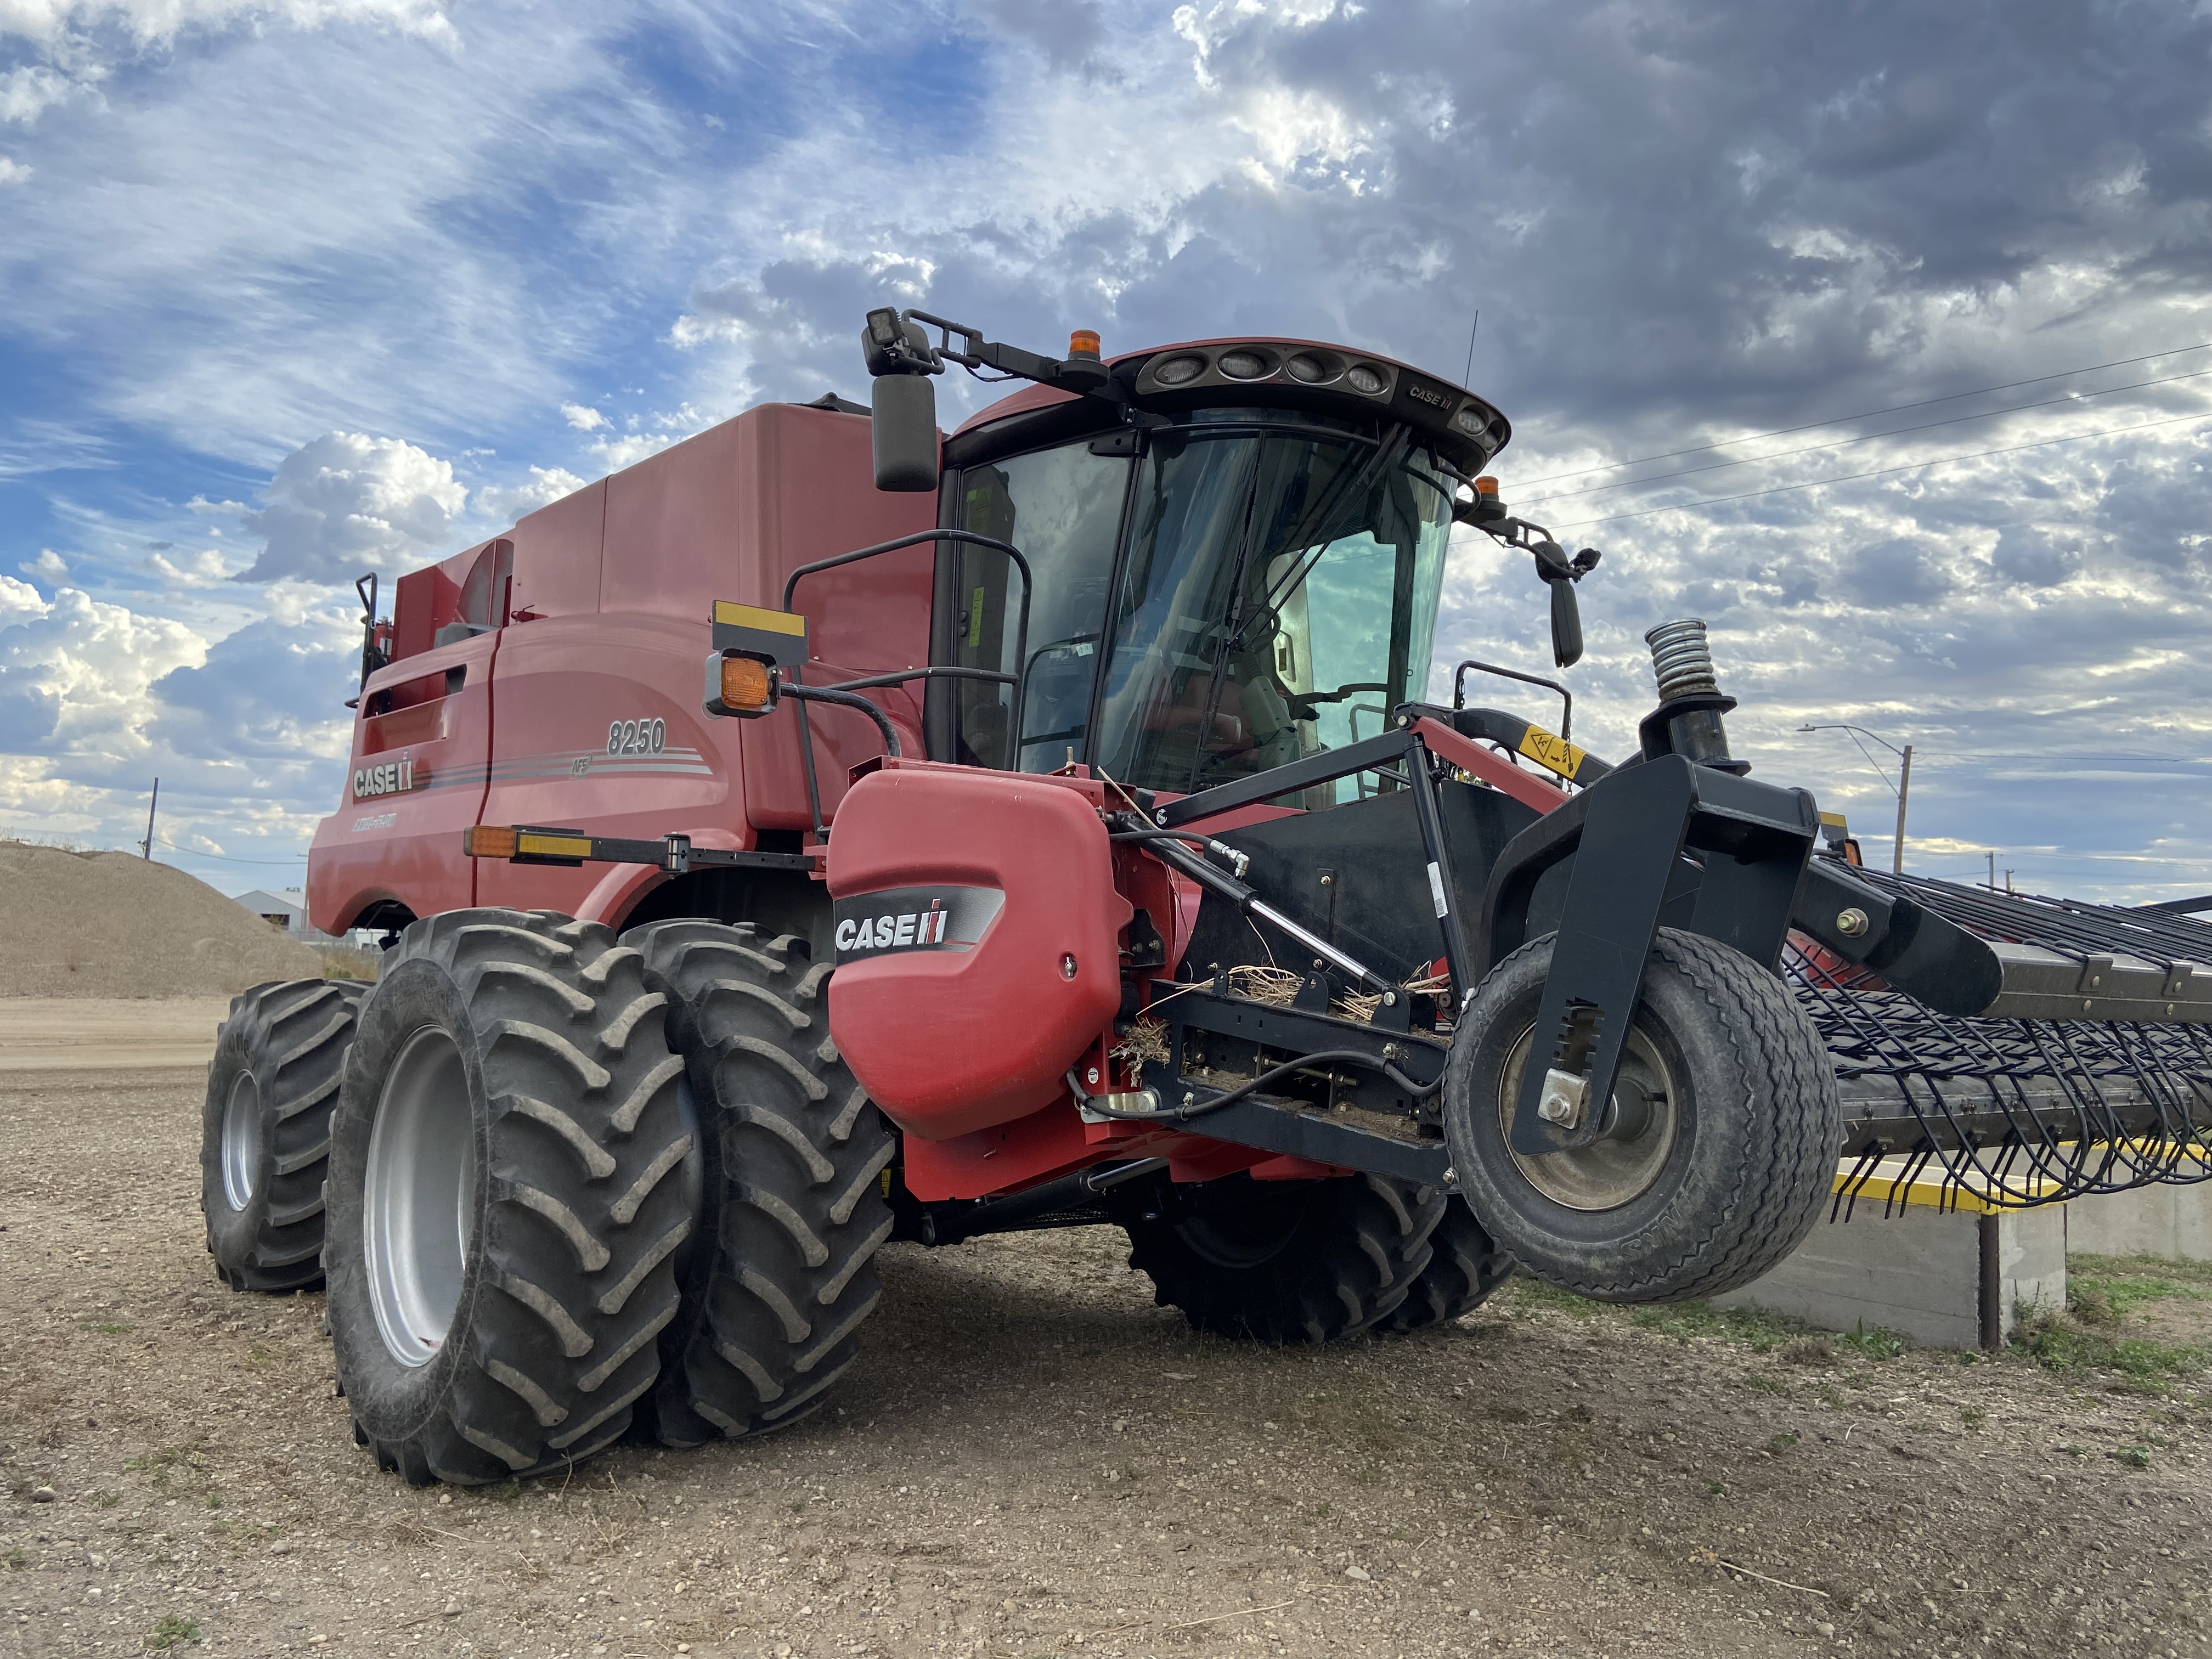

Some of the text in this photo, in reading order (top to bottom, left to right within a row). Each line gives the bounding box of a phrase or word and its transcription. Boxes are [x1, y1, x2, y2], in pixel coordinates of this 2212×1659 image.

[1410, 386, 1441, 405] CASE
[607, 717, 666, 757] 8250
[353, 763, 396, 797] CASE
[836, 913, 917, 951] CASE
